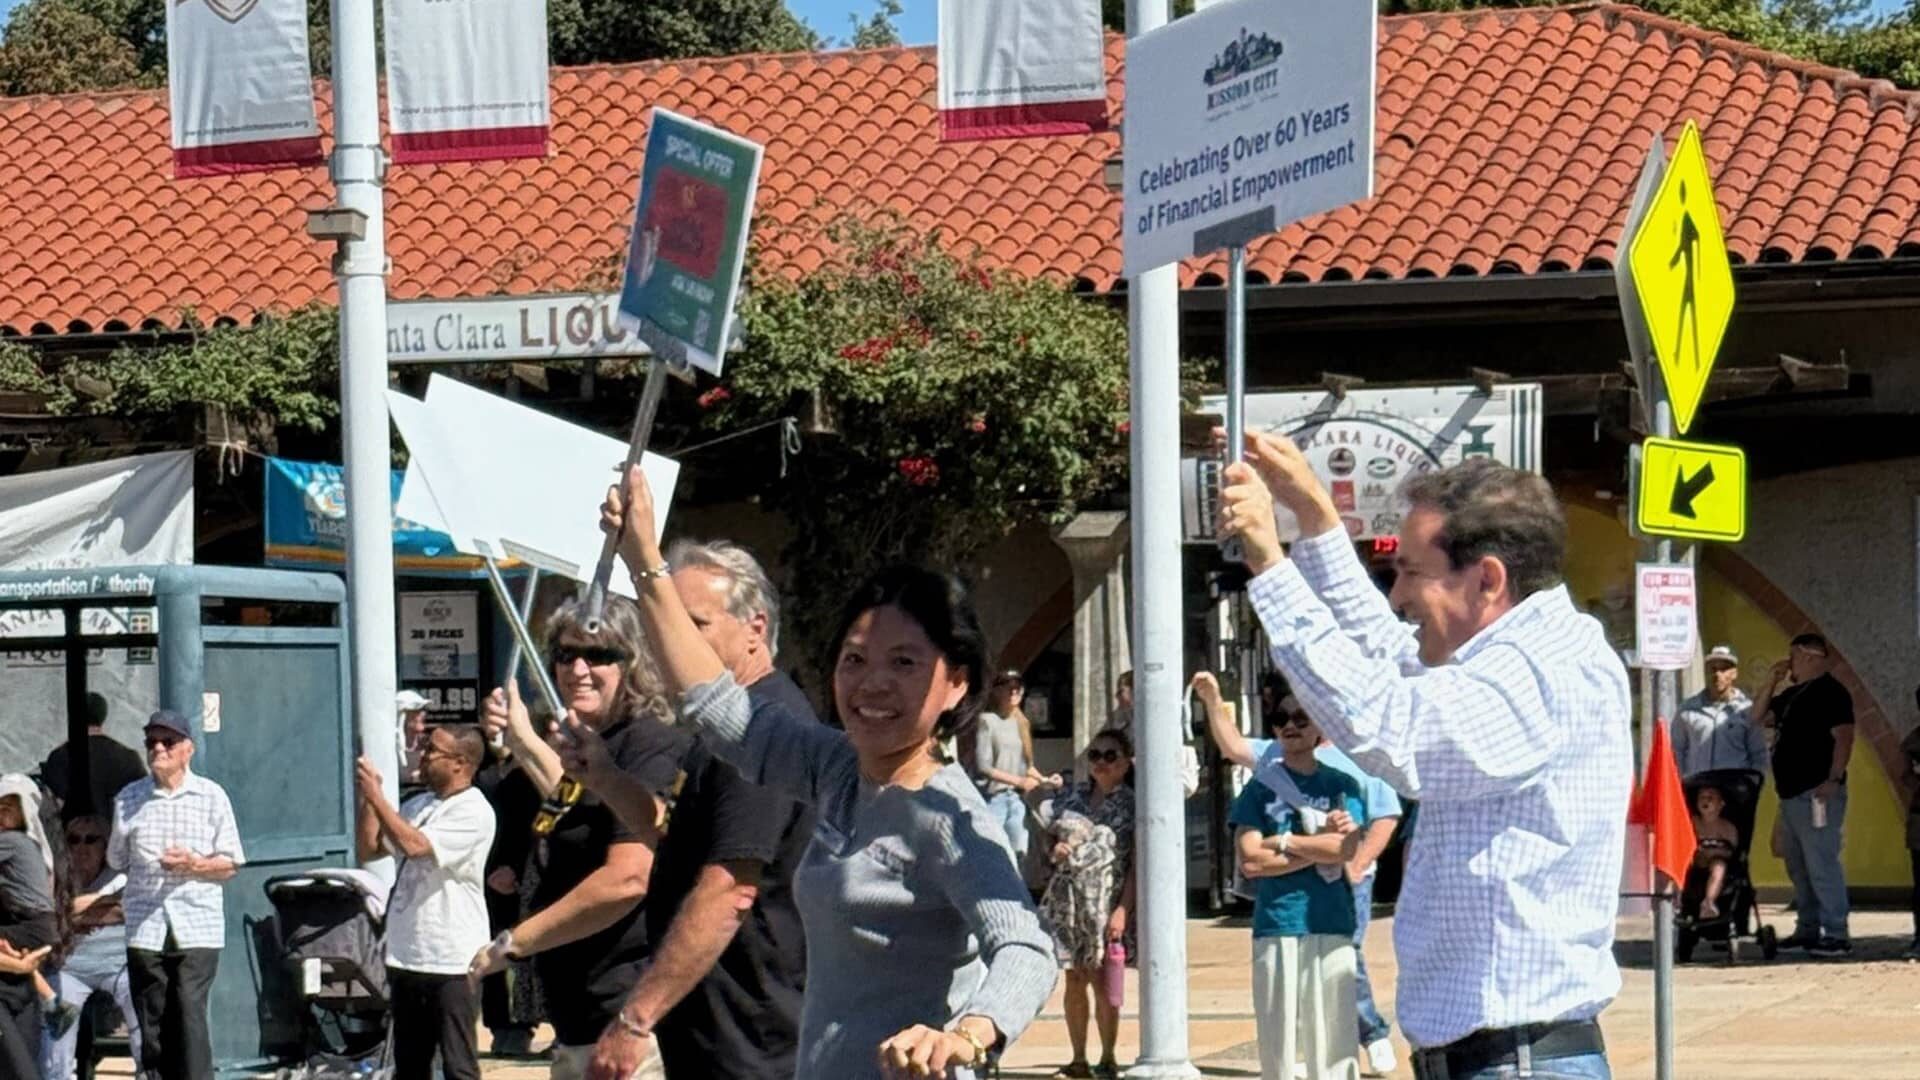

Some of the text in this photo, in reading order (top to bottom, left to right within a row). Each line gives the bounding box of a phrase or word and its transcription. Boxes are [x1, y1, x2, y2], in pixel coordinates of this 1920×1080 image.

[1140, 102, 1349, 195] Celebrating Over 60 Years
[1138, 138, 1355, 235] of Financial Empowerment
[387, 303, 626, 353] nta Clara LIQU
[1374, 434, 1431, 473] LIQUO
[0, 575, 88, 601] ansportation
[429, 628, 464, 639] PACKS
